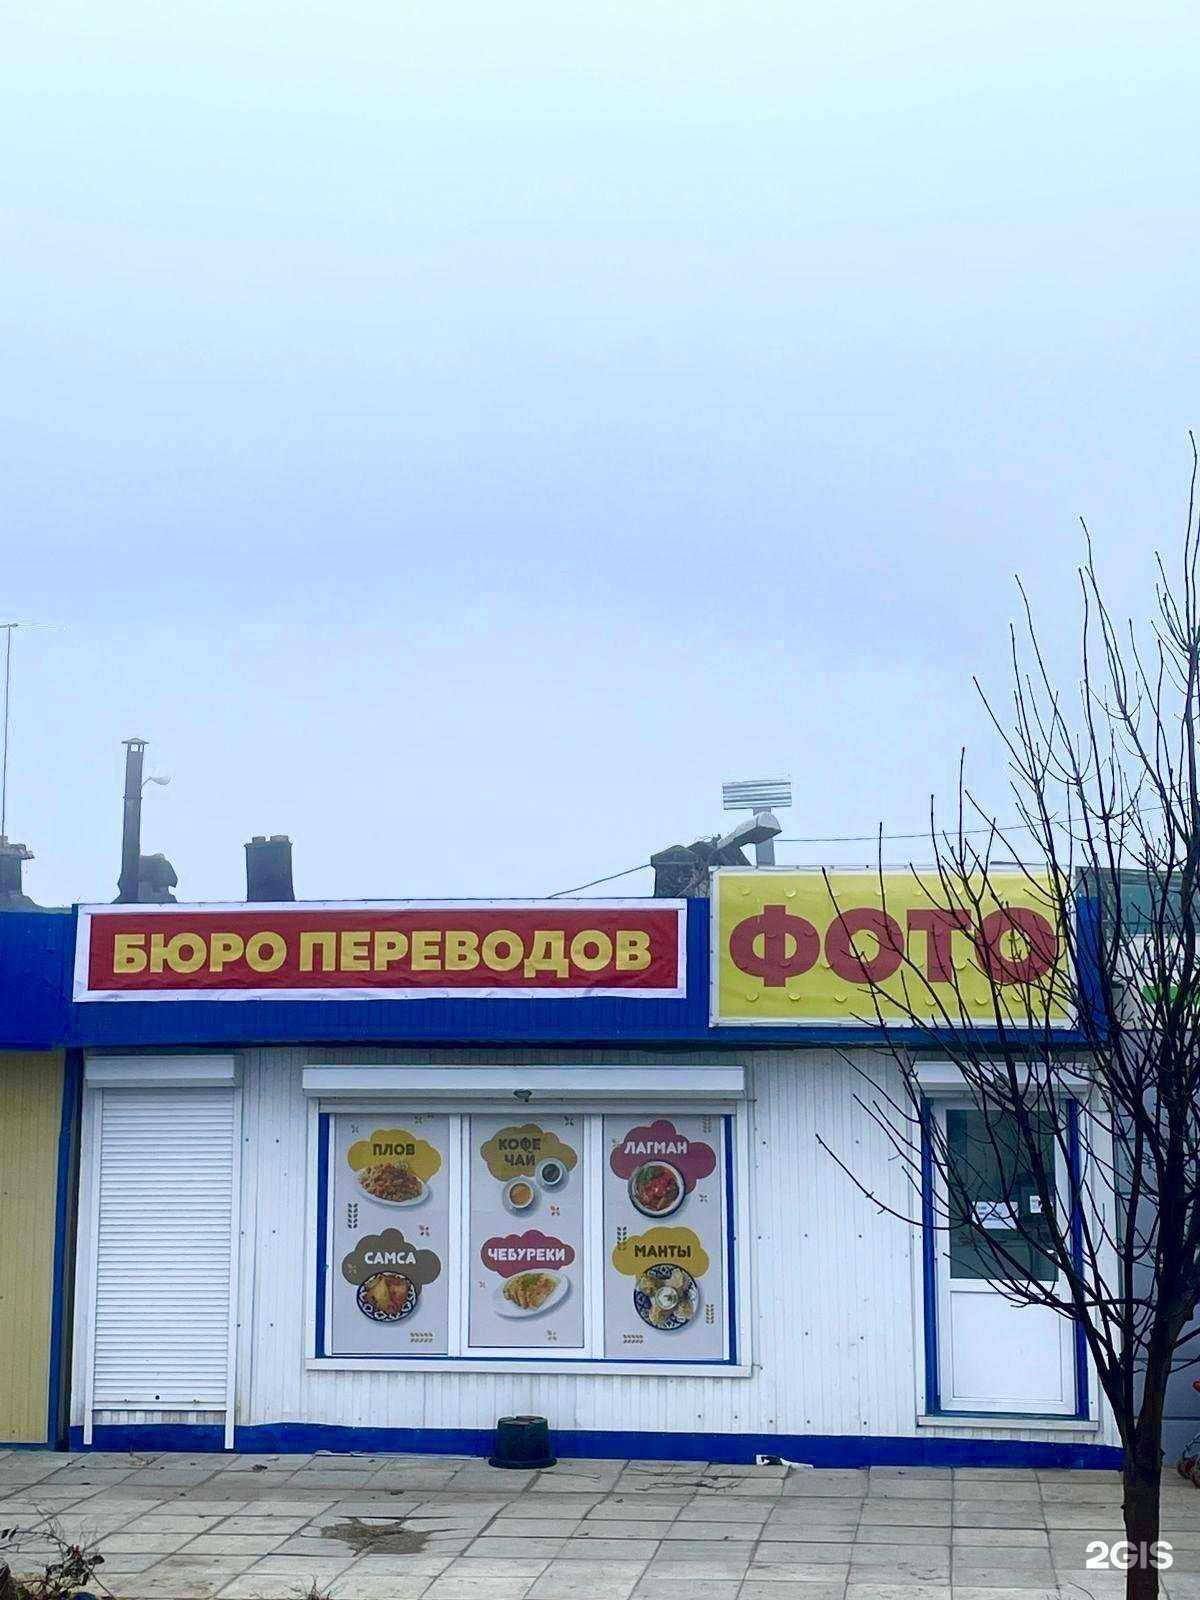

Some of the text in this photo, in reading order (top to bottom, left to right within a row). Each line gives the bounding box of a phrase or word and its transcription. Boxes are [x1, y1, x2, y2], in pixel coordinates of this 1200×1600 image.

[729, 904, 1058, 987] ФОТО
[113, 928, 652, 979] БЮРО ПЕРЕВОДОВ
[372, 1143, 416, 1156] ПЛОВ
[498, 1137, 541, 1152] КОФЕ
[623, 1140, 688, 1155] ЛАГМАН
[504, 1151, 536, 1167] ЧАЙ
[364, 1250, 417, 1266] САМСА
[487, 1247, 566, 1262] ЧЕБУРЕКИ
[634, 1244, 692, 1259] МАНТЫ
